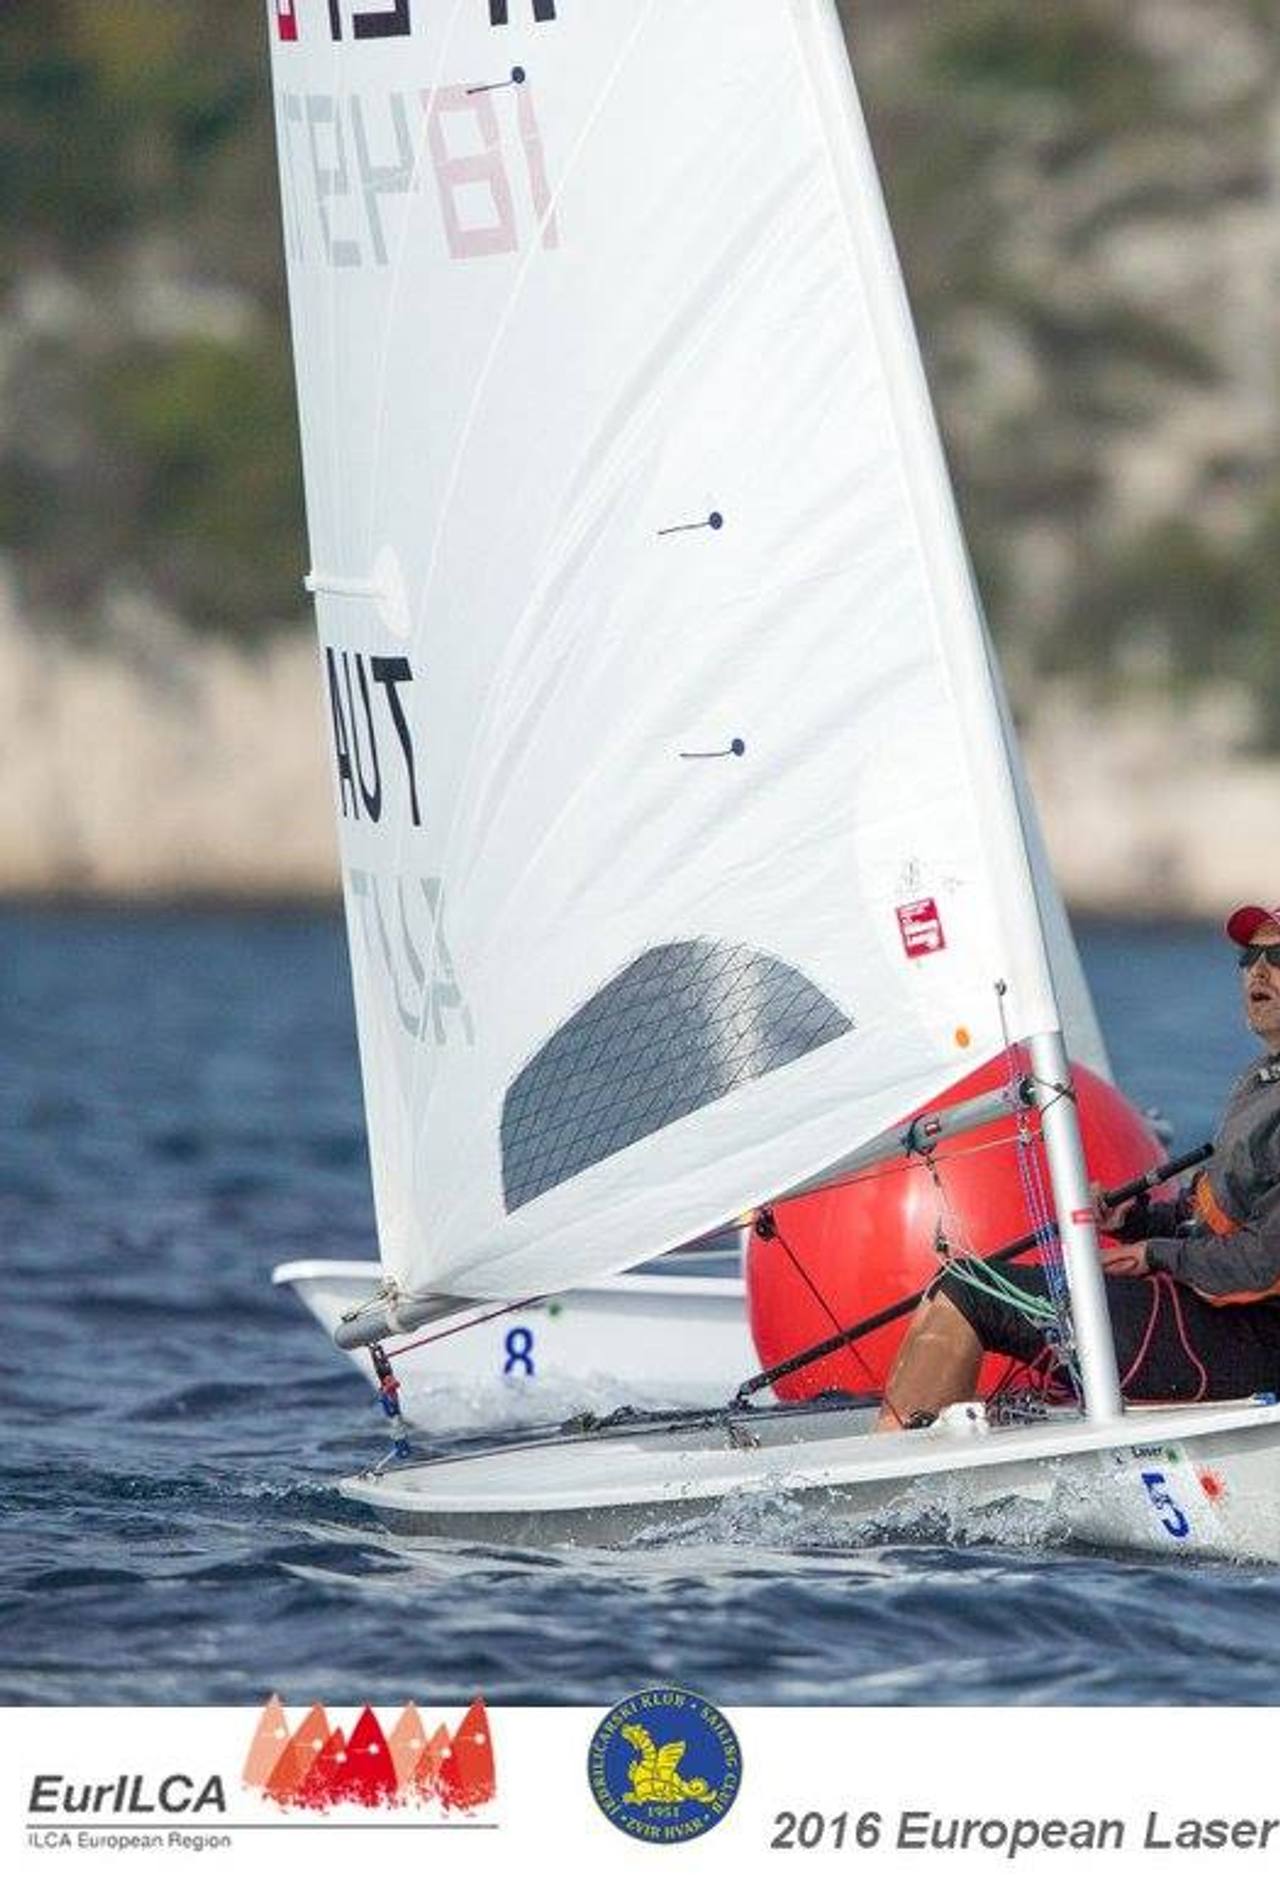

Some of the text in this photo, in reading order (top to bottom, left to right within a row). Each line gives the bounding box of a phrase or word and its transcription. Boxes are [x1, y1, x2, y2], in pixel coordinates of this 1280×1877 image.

[326, 646, 421, 827] AUT
[504, 1327, 534, 1376] 8
[1141, 1472, 1190, 1538] 5
